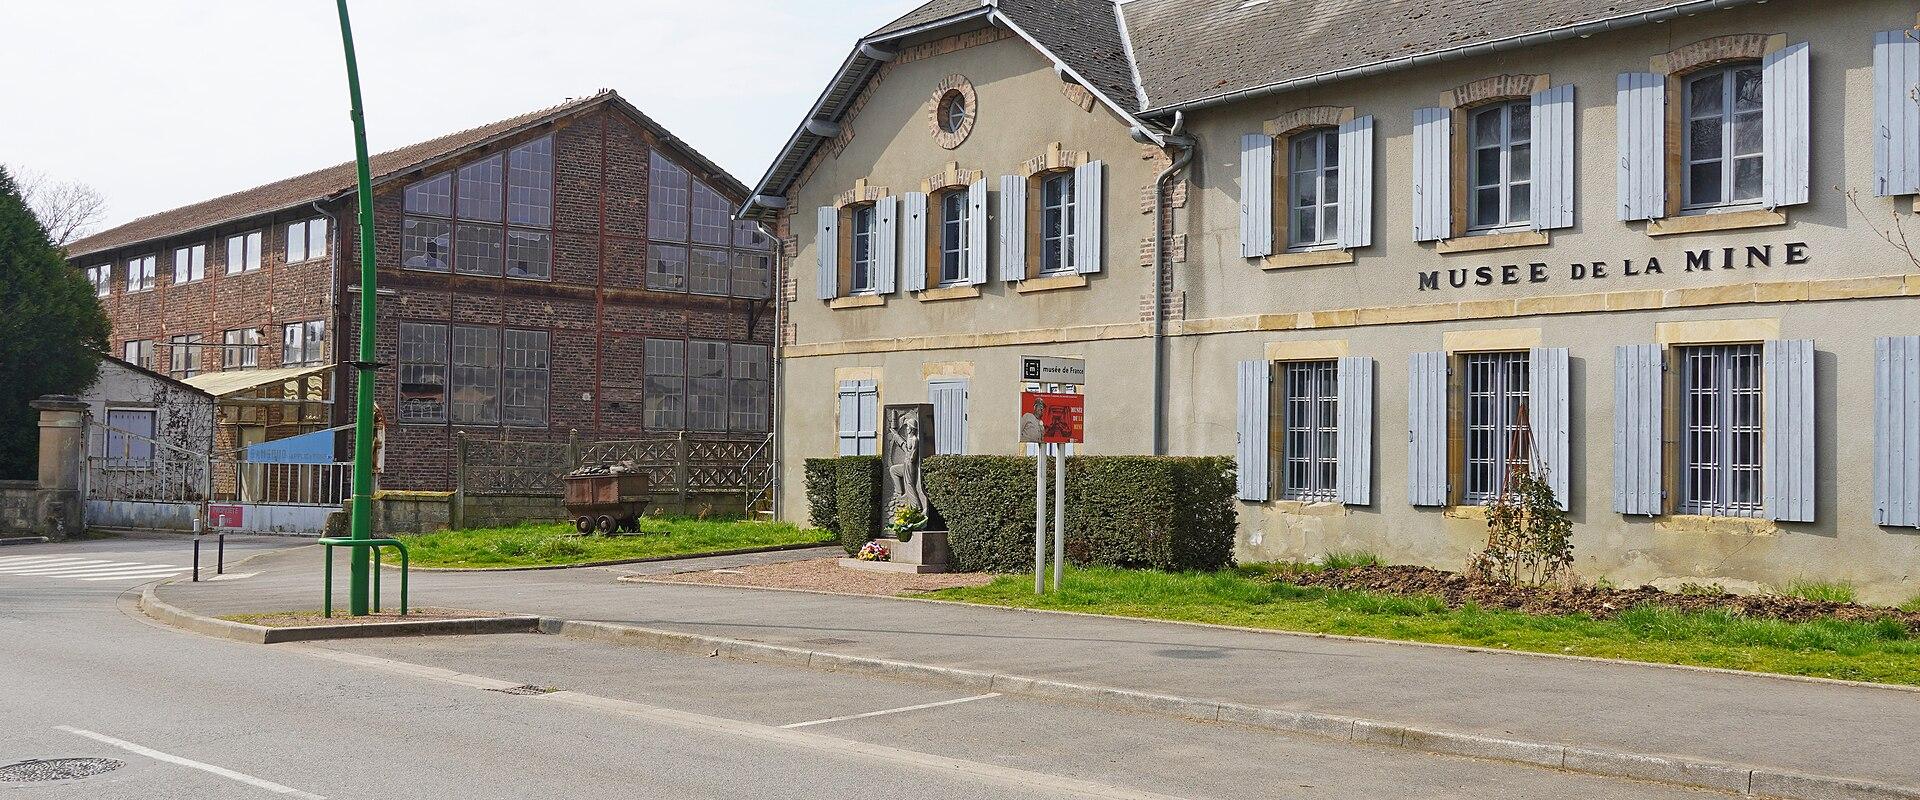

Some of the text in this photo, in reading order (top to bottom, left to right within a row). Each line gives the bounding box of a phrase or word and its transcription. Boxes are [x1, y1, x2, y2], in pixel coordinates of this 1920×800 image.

[1418, 242, 1811, 291] MUSEE DE LA MINE
[1042, 365, 1084, 375] musée de France
